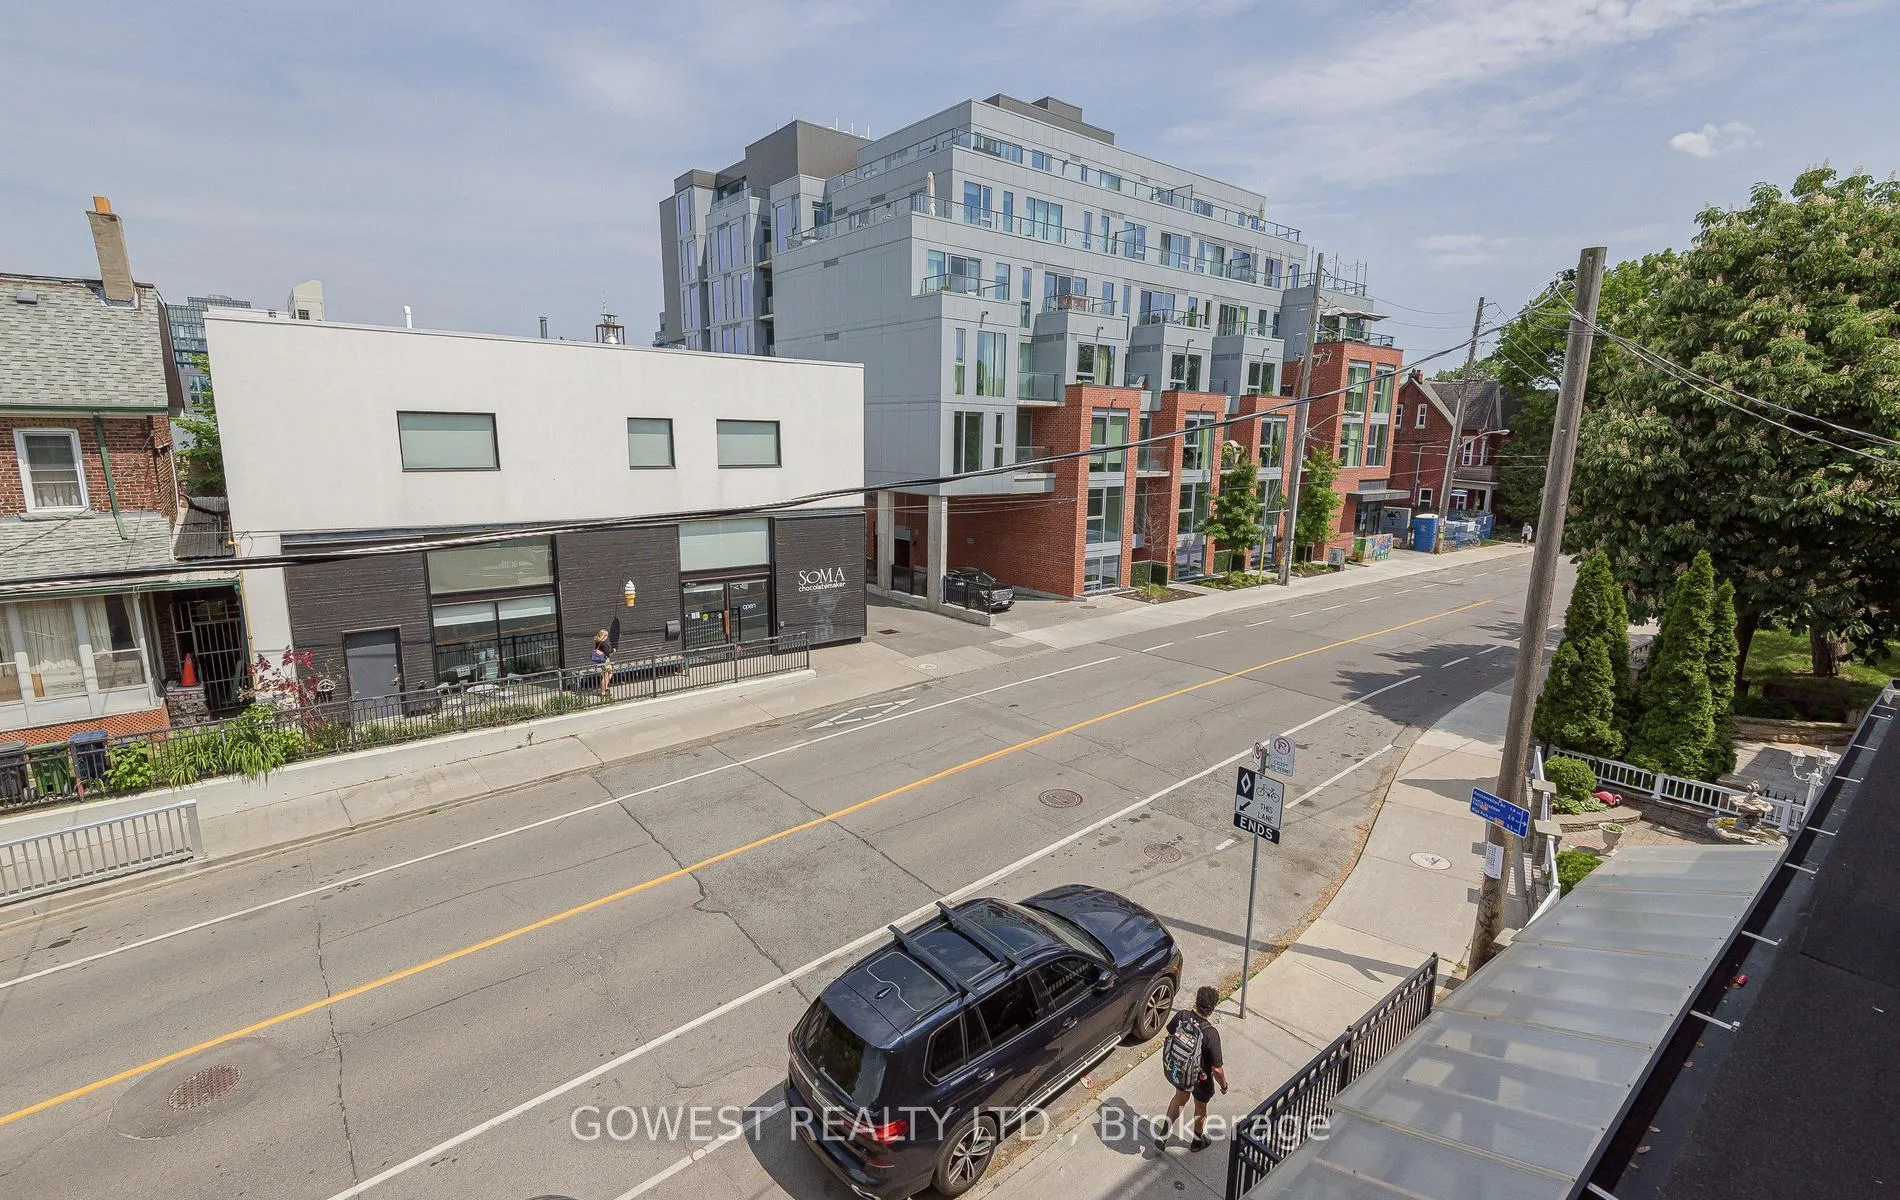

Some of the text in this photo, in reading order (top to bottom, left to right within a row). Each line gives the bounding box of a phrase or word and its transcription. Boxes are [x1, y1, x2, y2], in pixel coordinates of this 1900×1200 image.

[798, 566, 846, 586] SOMA
[798, 580, 846, 592] chocolatemaker
[742, 603, 757, 611] open
[1260, 802, 1274, 815] THIS
[1257, 811, 1274, 824] LANE
[1240, 817, 1273, 840] ENDS
